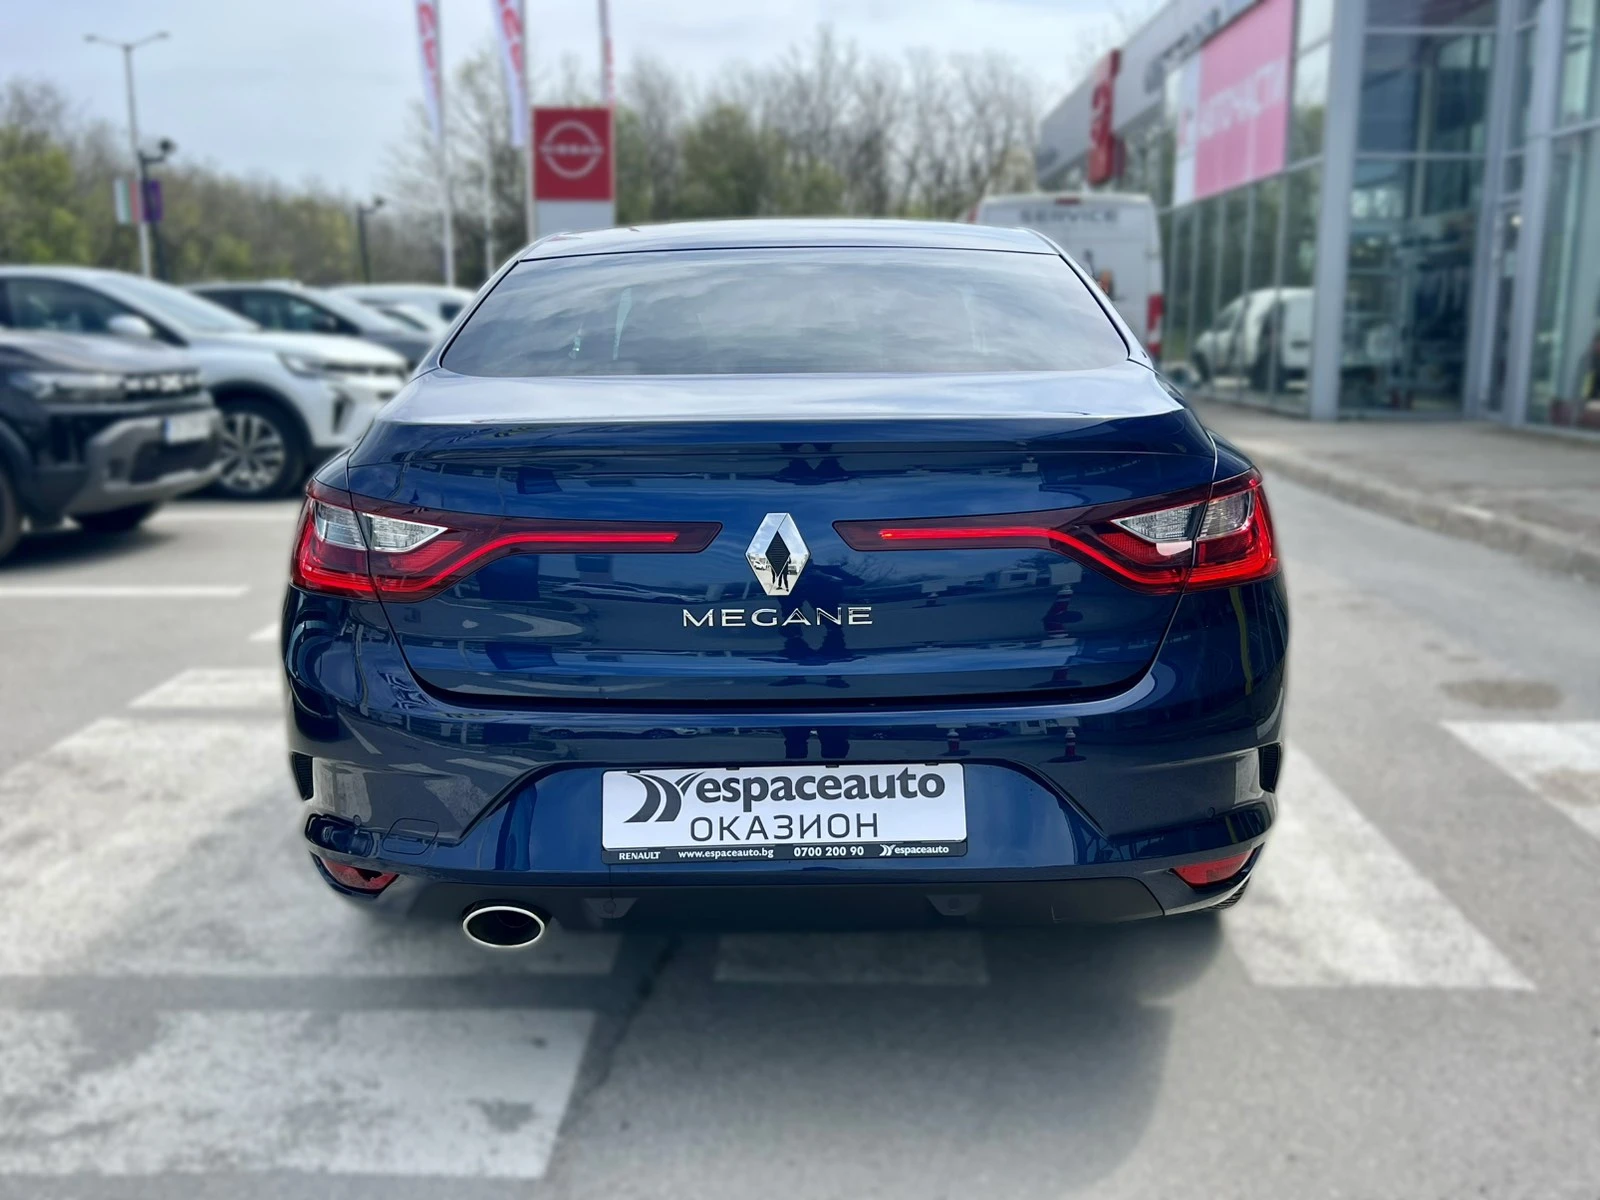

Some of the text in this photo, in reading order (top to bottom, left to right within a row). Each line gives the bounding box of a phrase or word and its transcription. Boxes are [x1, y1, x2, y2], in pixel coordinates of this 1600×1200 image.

[682, 606, 873, 627] MEGANE
[695, 767, 945, 812] espaceauto
[689, 812, 879, 842] ОКАЗИОН
[618, 843, 950, 861] RENAULT www.espaceauto.bg 0700 200 90 espaceauto
